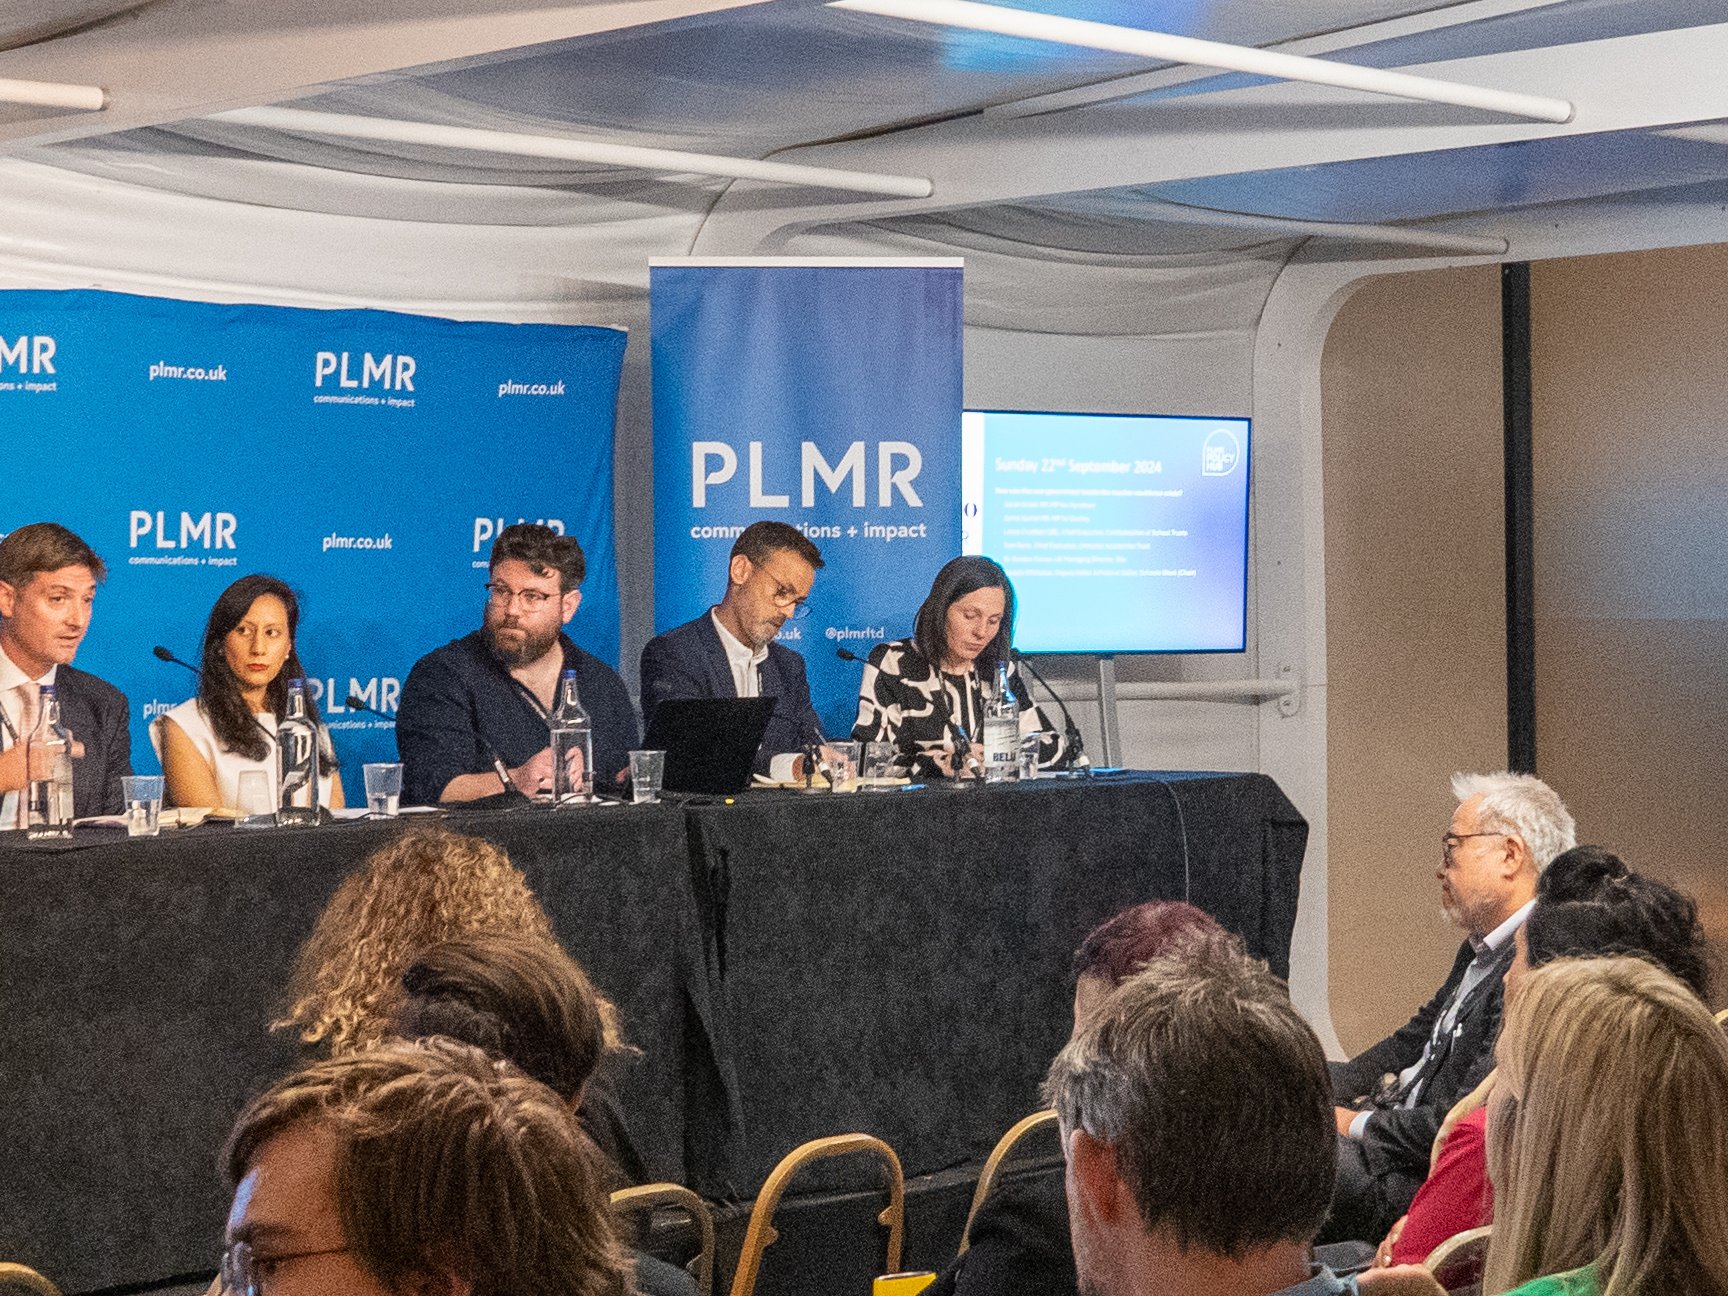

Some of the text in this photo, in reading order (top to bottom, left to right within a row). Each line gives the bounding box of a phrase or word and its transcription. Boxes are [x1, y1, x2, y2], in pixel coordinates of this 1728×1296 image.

[149, 361, 226, 380] plmr.co.uk
[315, 352, 416, 391] PLMR
[24, 382, 56, 393] impact
[498, 380, 565, 398] plmr.co.uk
[314, 395, 380, 404] communications
[387, 397, 415, 407] impact
[693, 441, 923, 508] PLMR
[995, 457, 1037, 474] Sunday
[1068, 459, 1131, 475] September
[1133, 460, 1162, 474] 2024
[130, 511, 237, 549] PLMR
[847, 526, 857, 537] +
[864, 522, 926, 542] impact
[323, 533, 392, 551] plmr.co.uk
[129, 556, 199, 565] communications
[208, 557, 237, 566] impact
[825, 627, 885, 641] @plmrltd
